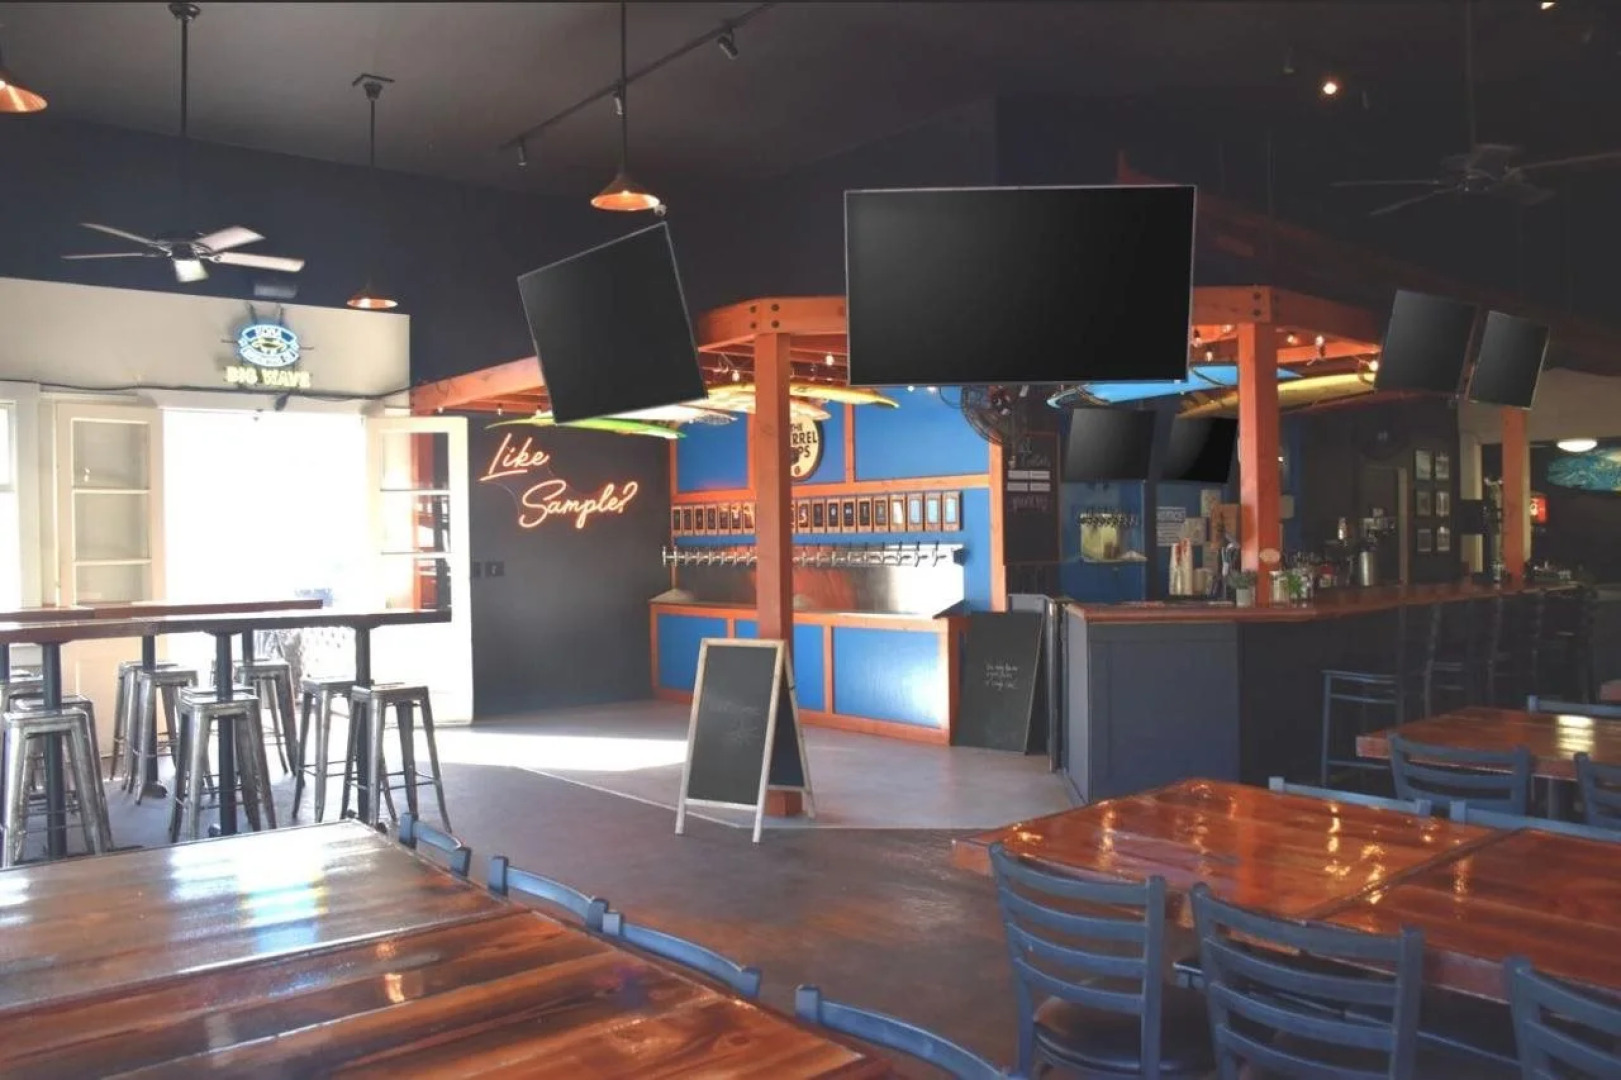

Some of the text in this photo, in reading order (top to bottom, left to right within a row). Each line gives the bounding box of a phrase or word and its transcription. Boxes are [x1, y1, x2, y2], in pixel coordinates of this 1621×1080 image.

[226, 365, 311, 388] BIG WAVE
[792, 431, 817, 444] RREL
[478, 432, 550, 482] Like
[518, 479, 639, 529] Sample?
